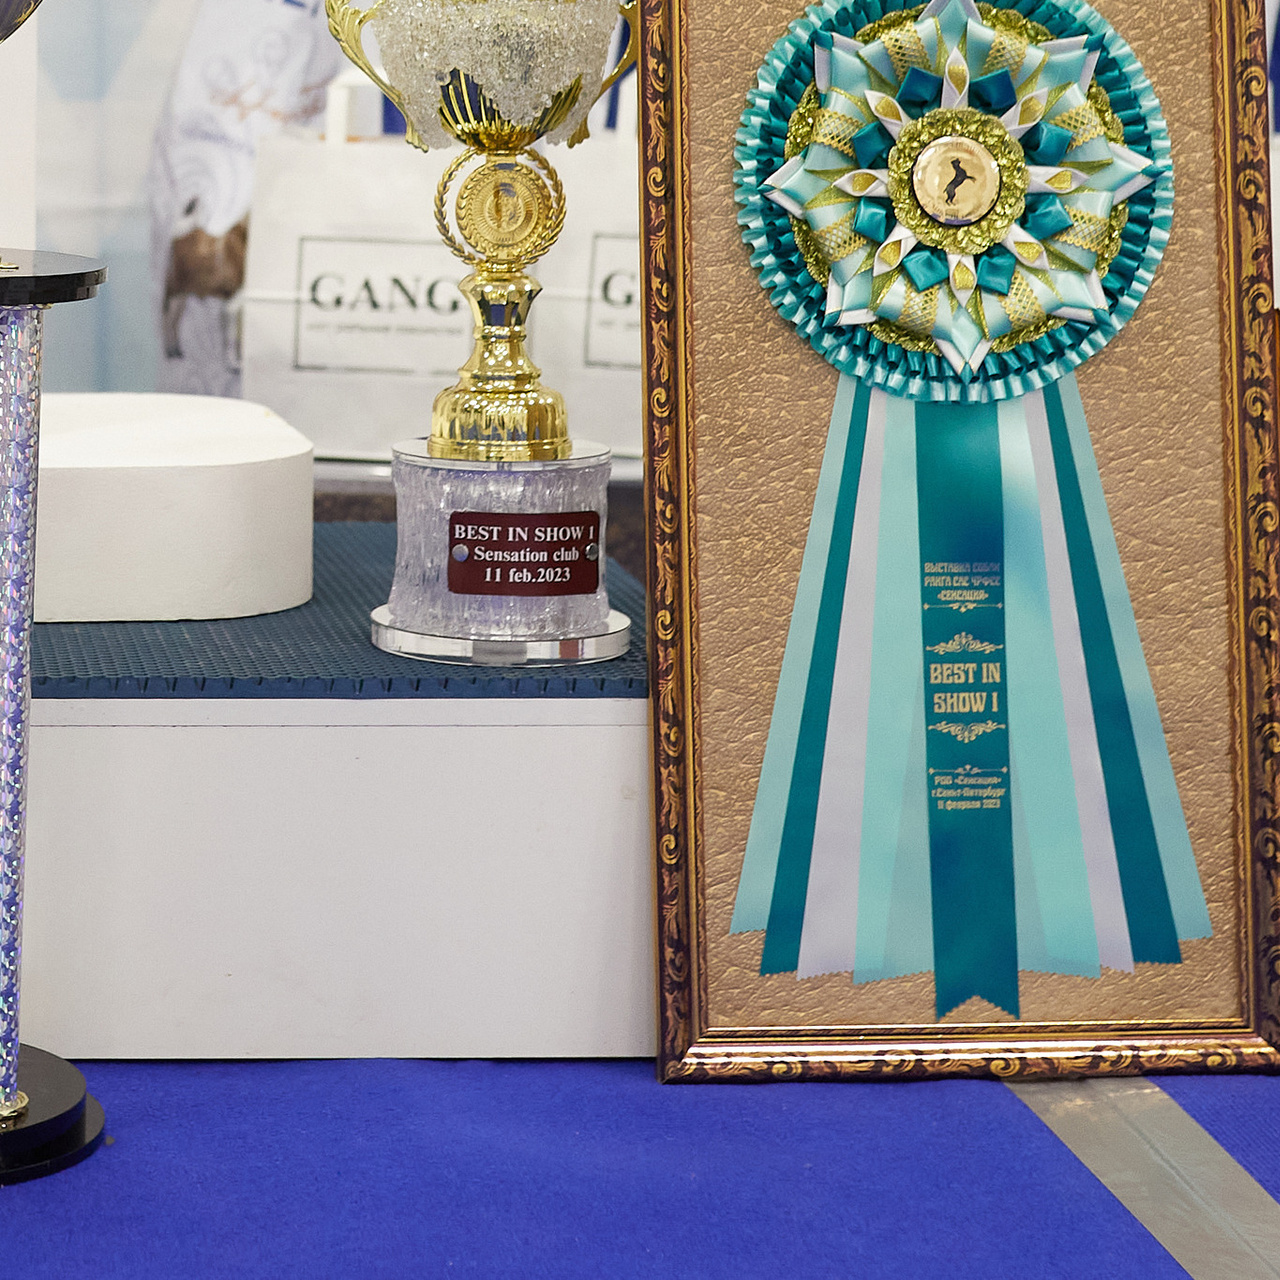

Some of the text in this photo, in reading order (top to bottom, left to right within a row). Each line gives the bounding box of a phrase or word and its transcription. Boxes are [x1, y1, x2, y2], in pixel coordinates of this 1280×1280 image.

[310, 273, 461, 314] GANG
[454, 524, 594, 542] BEST IN SHOW 1
[473, 545, 580, 562] Sensation club
[485, 567, 571, 583] 11 feb.2023
[929, 662, 1001, 685] BEST IN
[933, 692, 986, 714] SHOW
